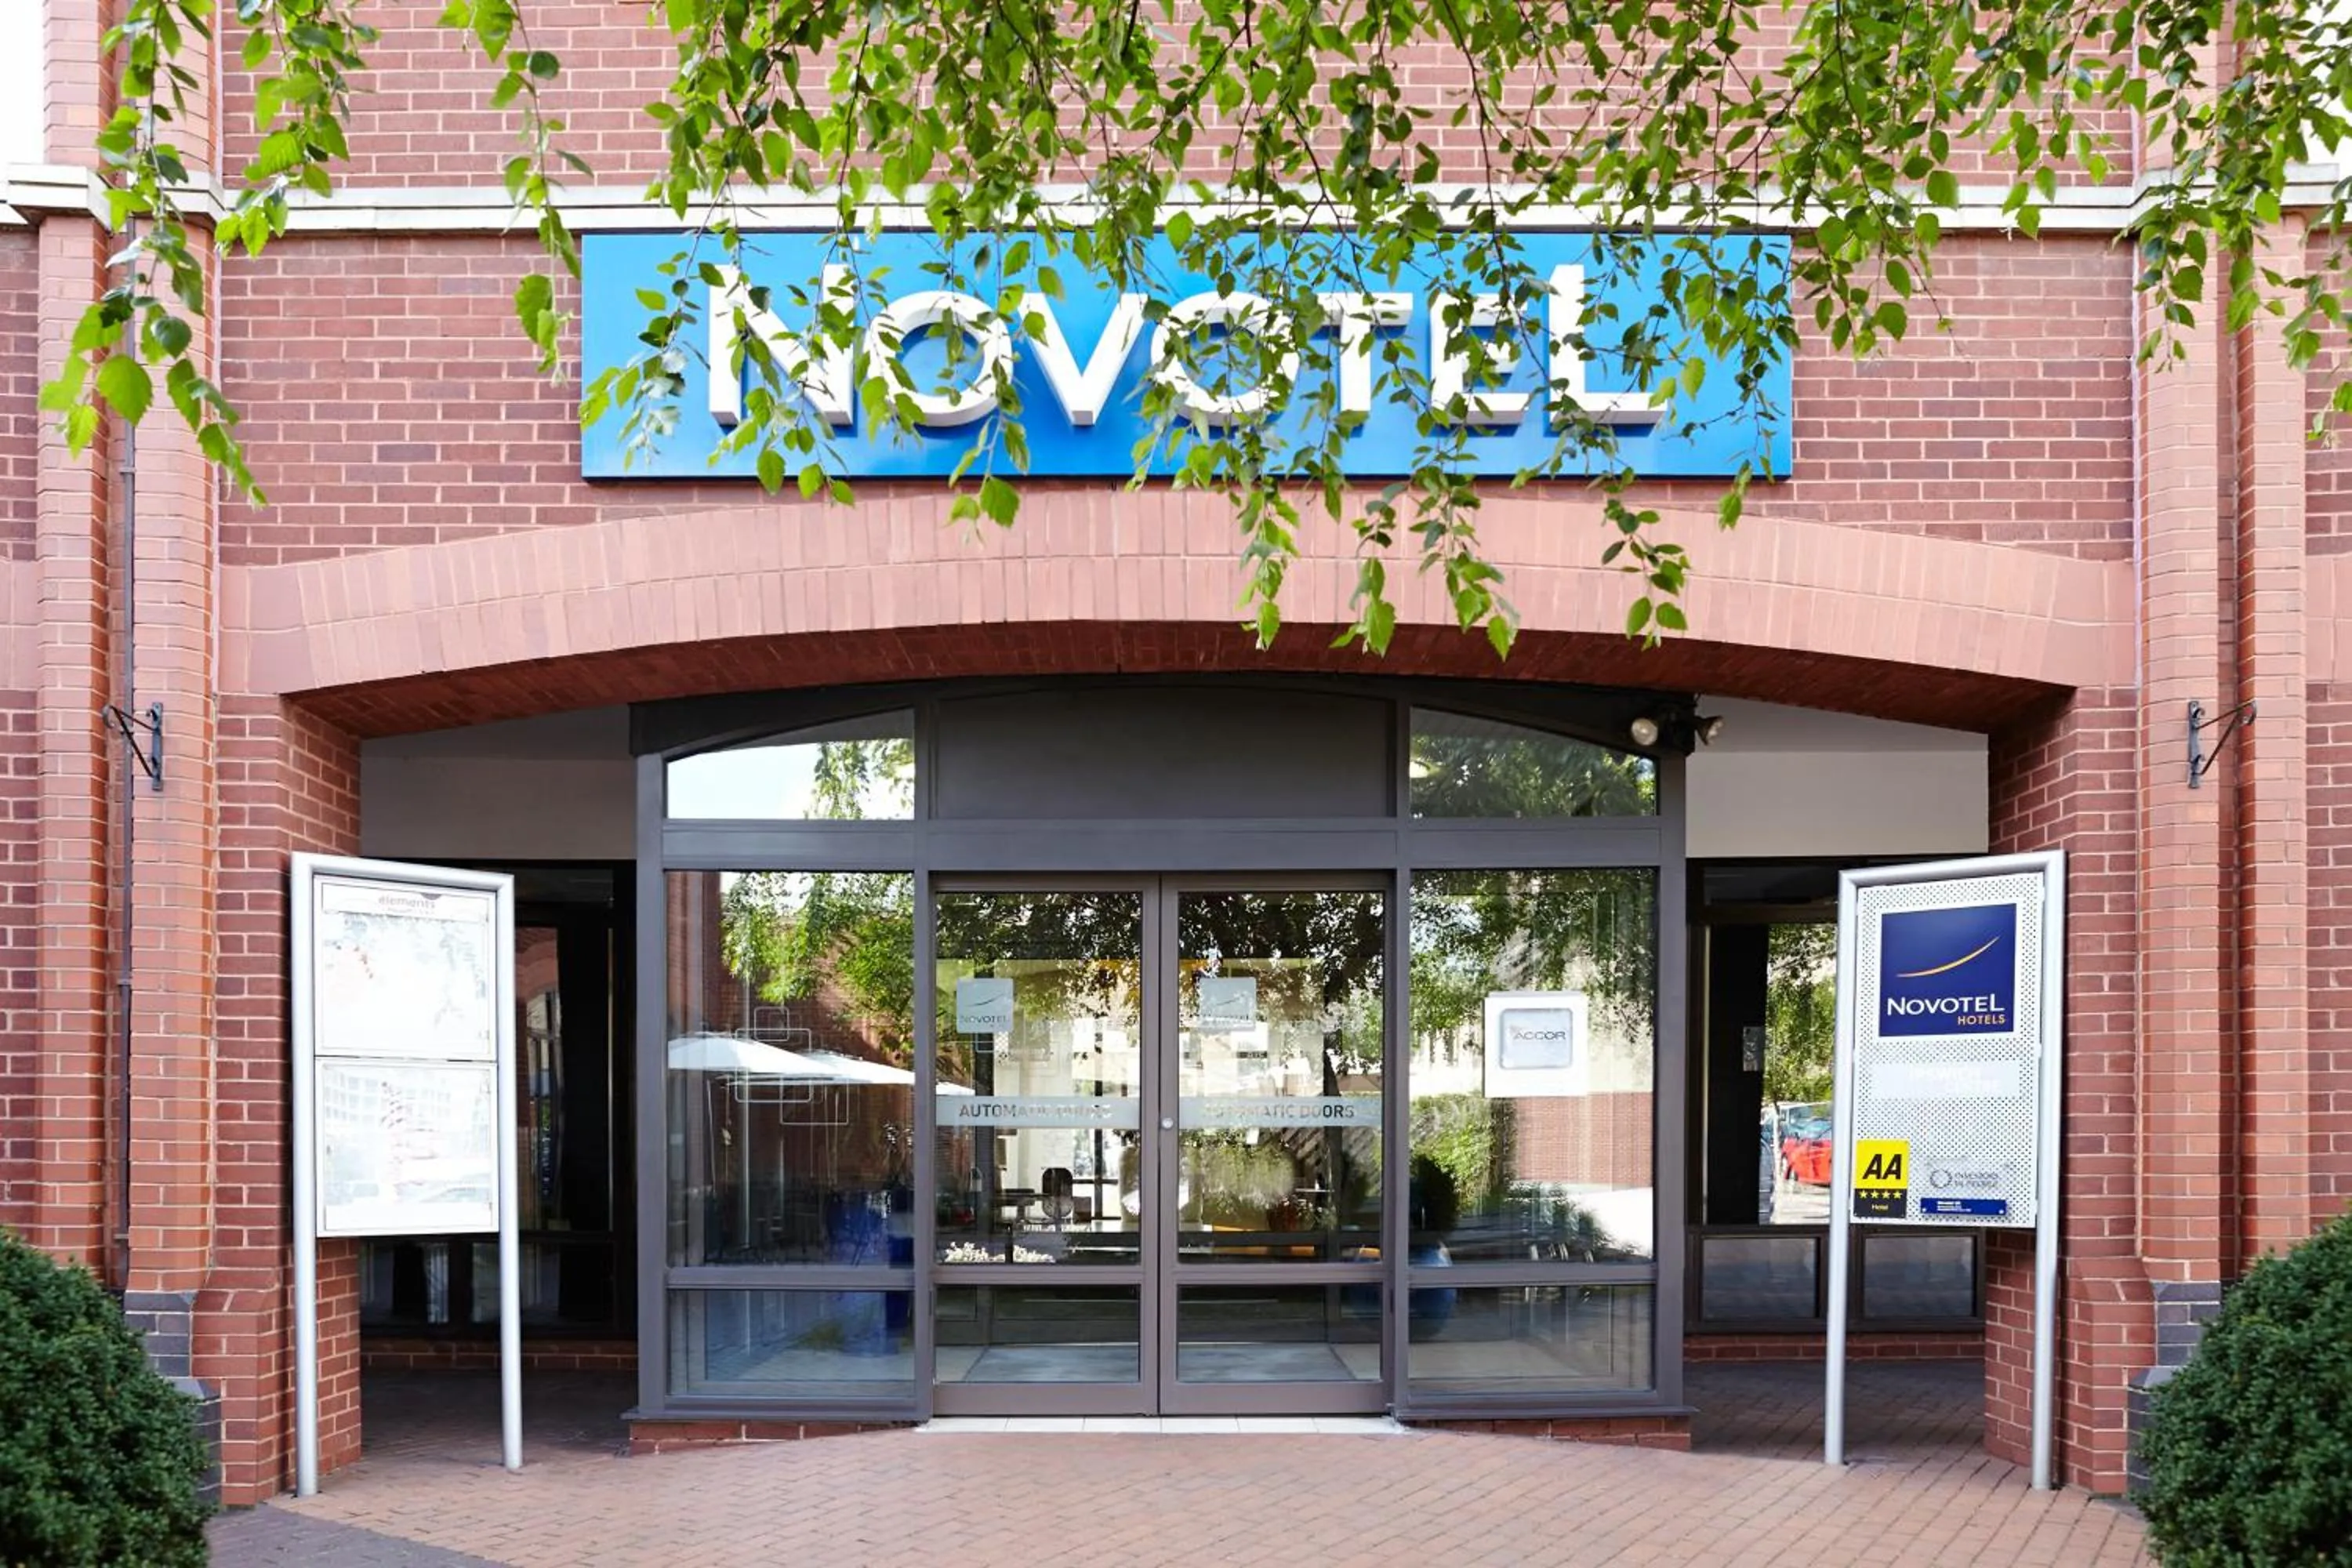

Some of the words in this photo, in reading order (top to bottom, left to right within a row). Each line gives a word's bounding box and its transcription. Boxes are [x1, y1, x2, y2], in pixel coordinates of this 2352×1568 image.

[708, 263, 1668, 426] NOVOTEL
[1886, 993, 2006, 1016] NOVOTEL
[1958, 1014, 2005, 1025] HOTELS
[1513, 1030, 1566, 1040] ACCOR
[1299, 1105, 1355, 1119] DOORS
[1862, 1153, 1903, 1180] AA
